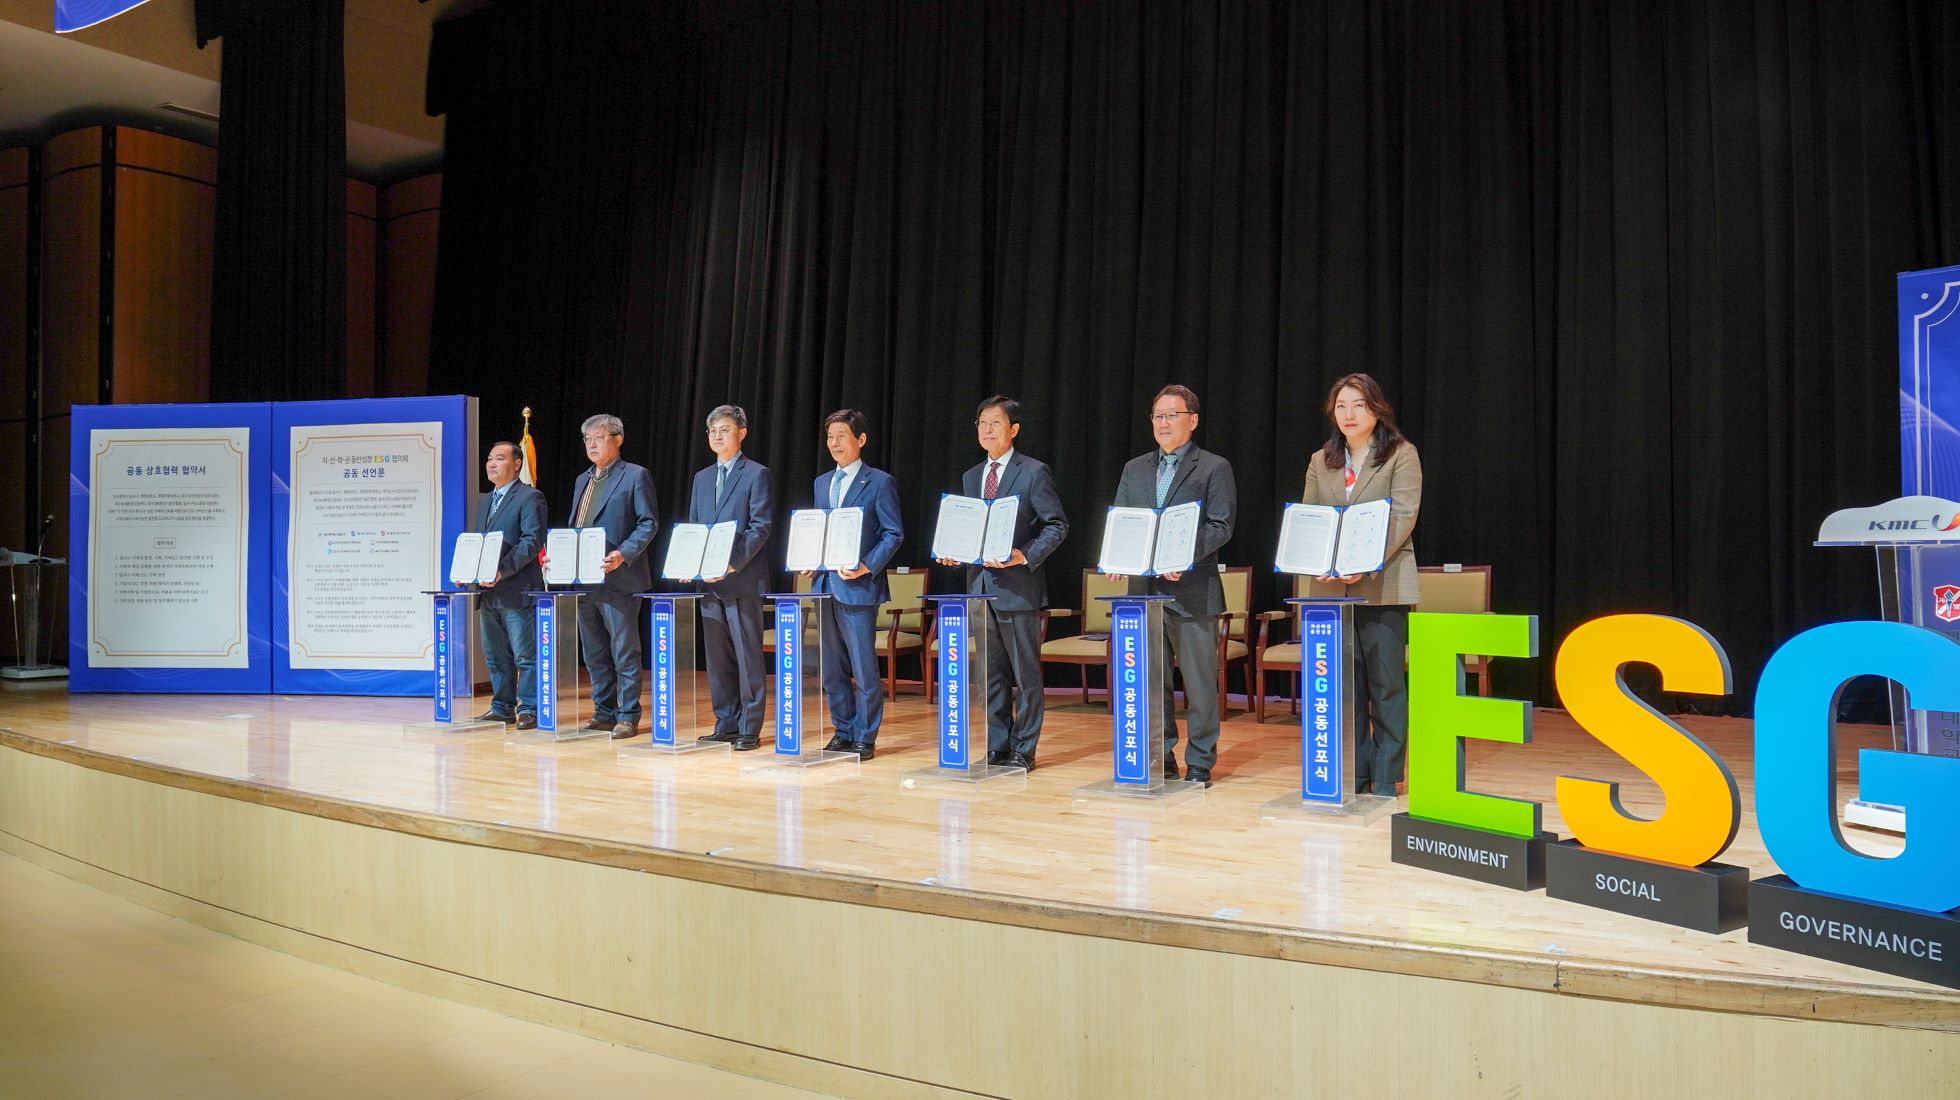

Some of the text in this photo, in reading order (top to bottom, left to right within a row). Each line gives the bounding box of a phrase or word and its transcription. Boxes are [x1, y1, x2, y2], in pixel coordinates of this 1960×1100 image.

[126, 465, 206, 476] 공동 상호협력 협약서
[343, 467, 385, 478] 공동 선언문
[374, 455, 390, 463] ESG
[784, 629, 792, 668] ESG
[784, 673, 792, 739] 공동선포식
[948, 633, 958, 752] ESG 공동선포식
[1124, 637, 1136, 766] ESG 공동선포식
[1314, 643, 1328, 781] ESG 공동선포식
[1407, 835, 1509, 869] ENVIRONMENT
[1595, 873, 1661, 902] SOCIAL
[1779, 911, 1943, 962] GOVERNANCE
